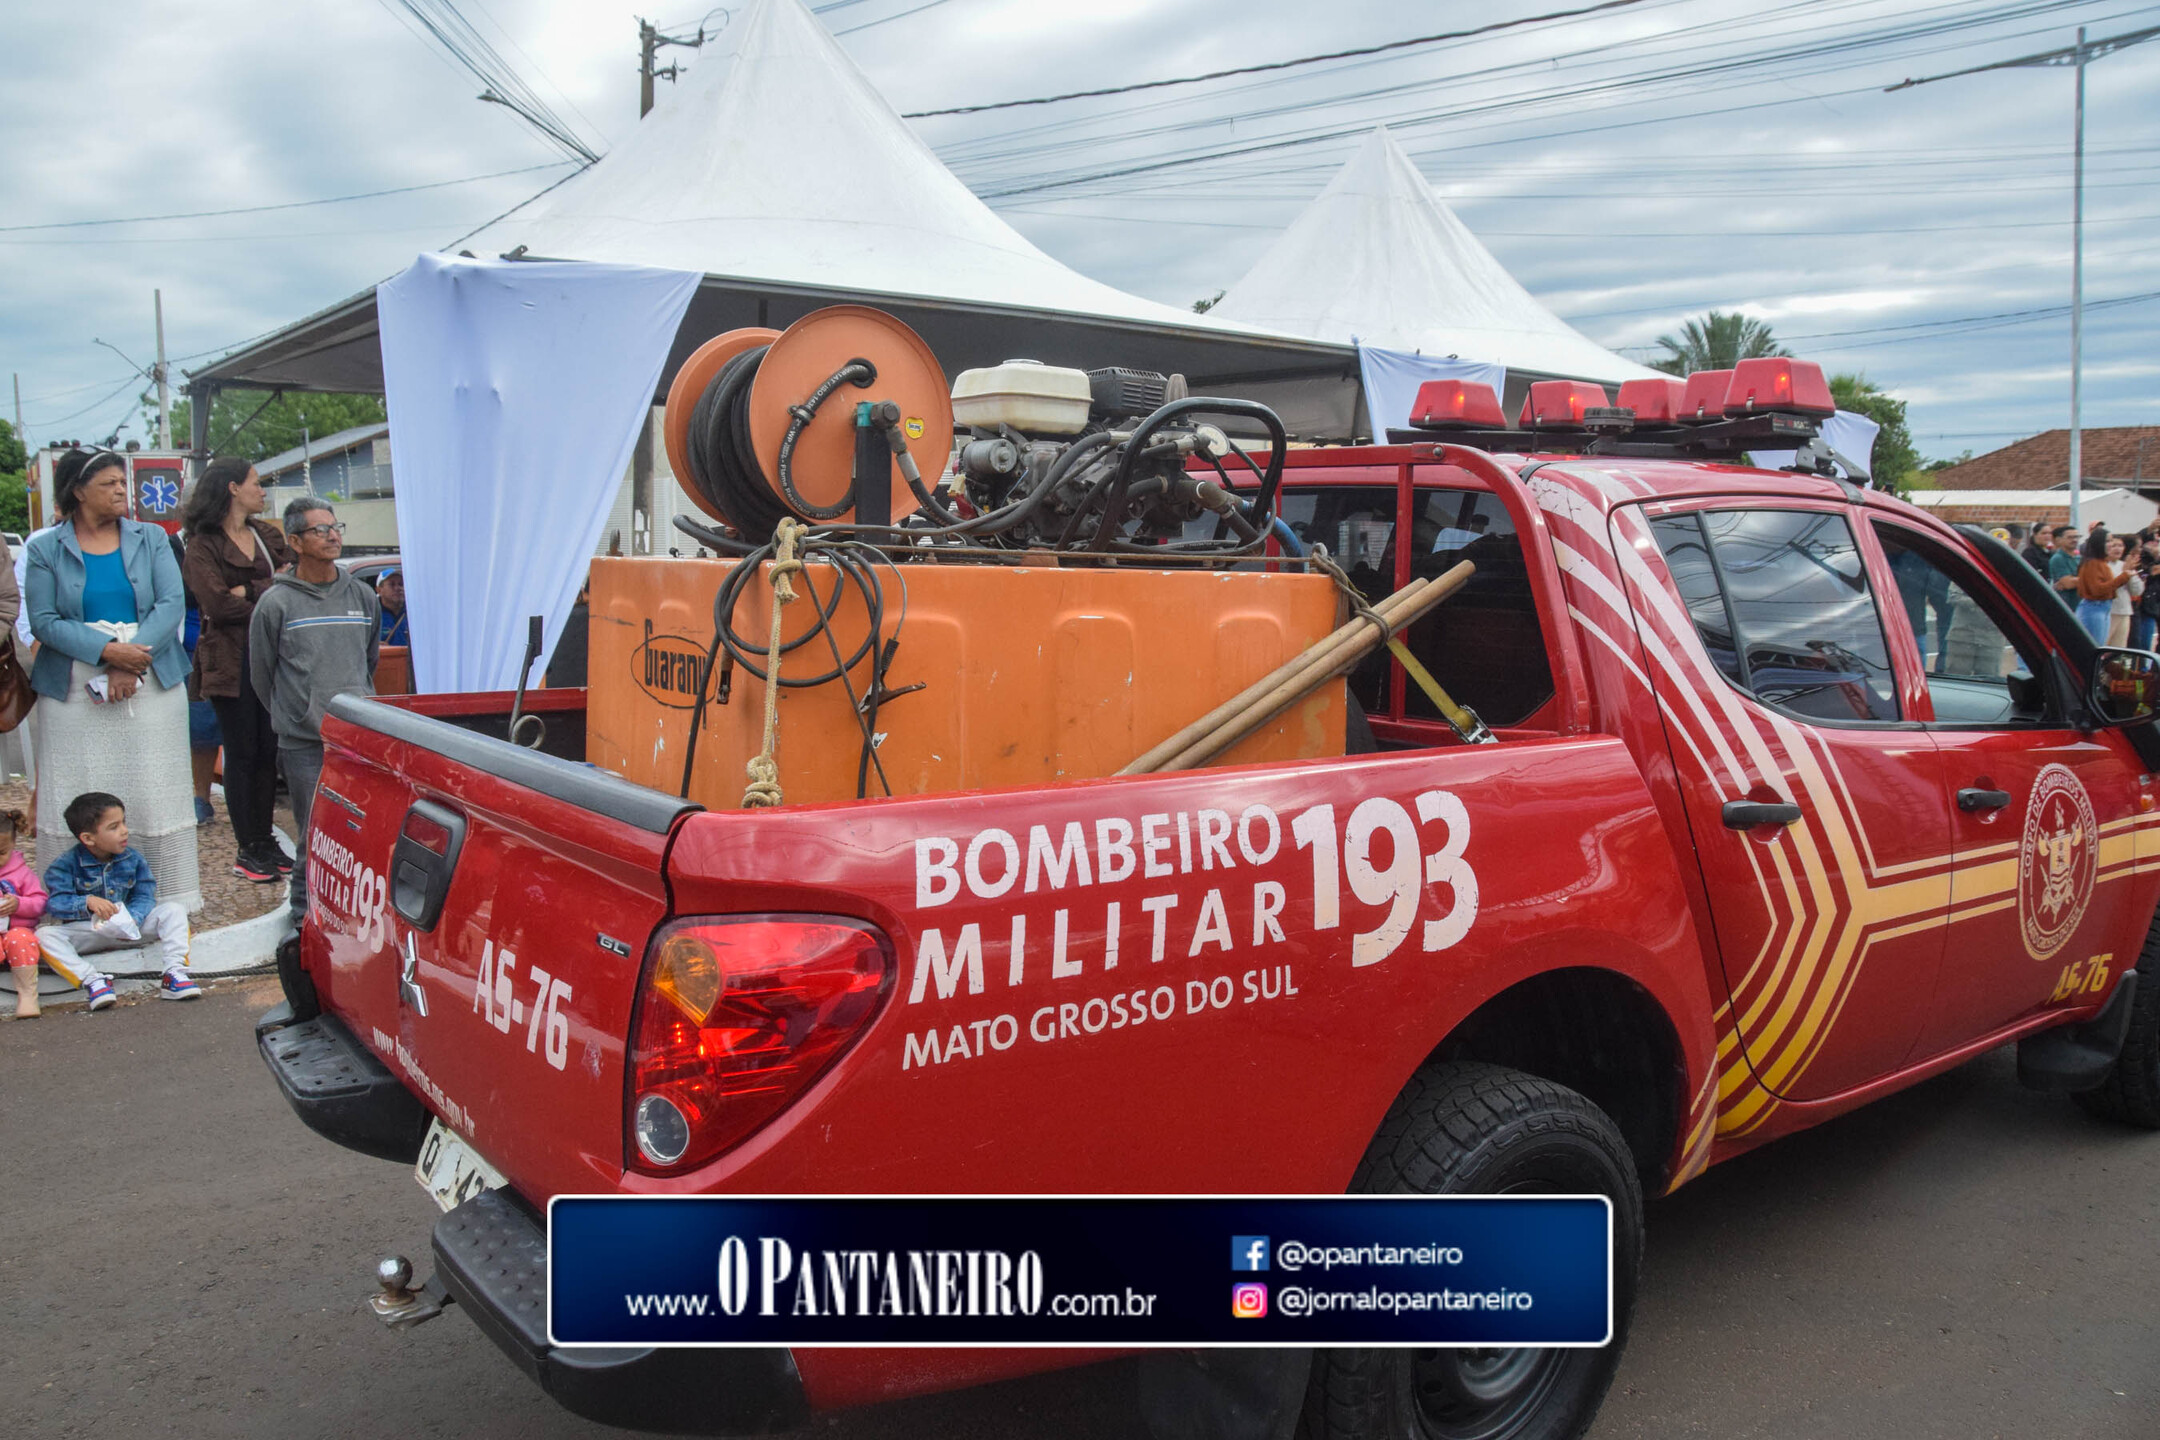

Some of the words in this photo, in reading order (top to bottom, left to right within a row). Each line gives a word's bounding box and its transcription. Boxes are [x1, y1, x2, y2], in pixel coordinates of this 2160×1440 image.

[2024, 819, 2036, 878] CORPO
[2032, 794, 2042, 818] DE
[2039, 773, 2079, 799] BOMBEIROS
[2079, 796, 2094, 855] MILITAR
[309, 858, 350, 914] MILITAR
[311, 826, 354, 879] BOMBEIRO
[351, 861, 386, 954] 193
[915, 803, 1282, 908] BOMBEIRO
[1292, 790, 1479, 967] 193
[599, 934, 626, 956] GL
[908, 881, 1287, 1004] MILITAR
[2045, 953, 2113, 1005] AS-76
[473, 938, 572, 1071] AS-76
[902, 1014, 1018, 1070] MATO
[1029, 985, 1176, 1043] GROSSO
[1187, 975, 1233, 1015] DO
[1244, 965, 1299, 1003] SUL
